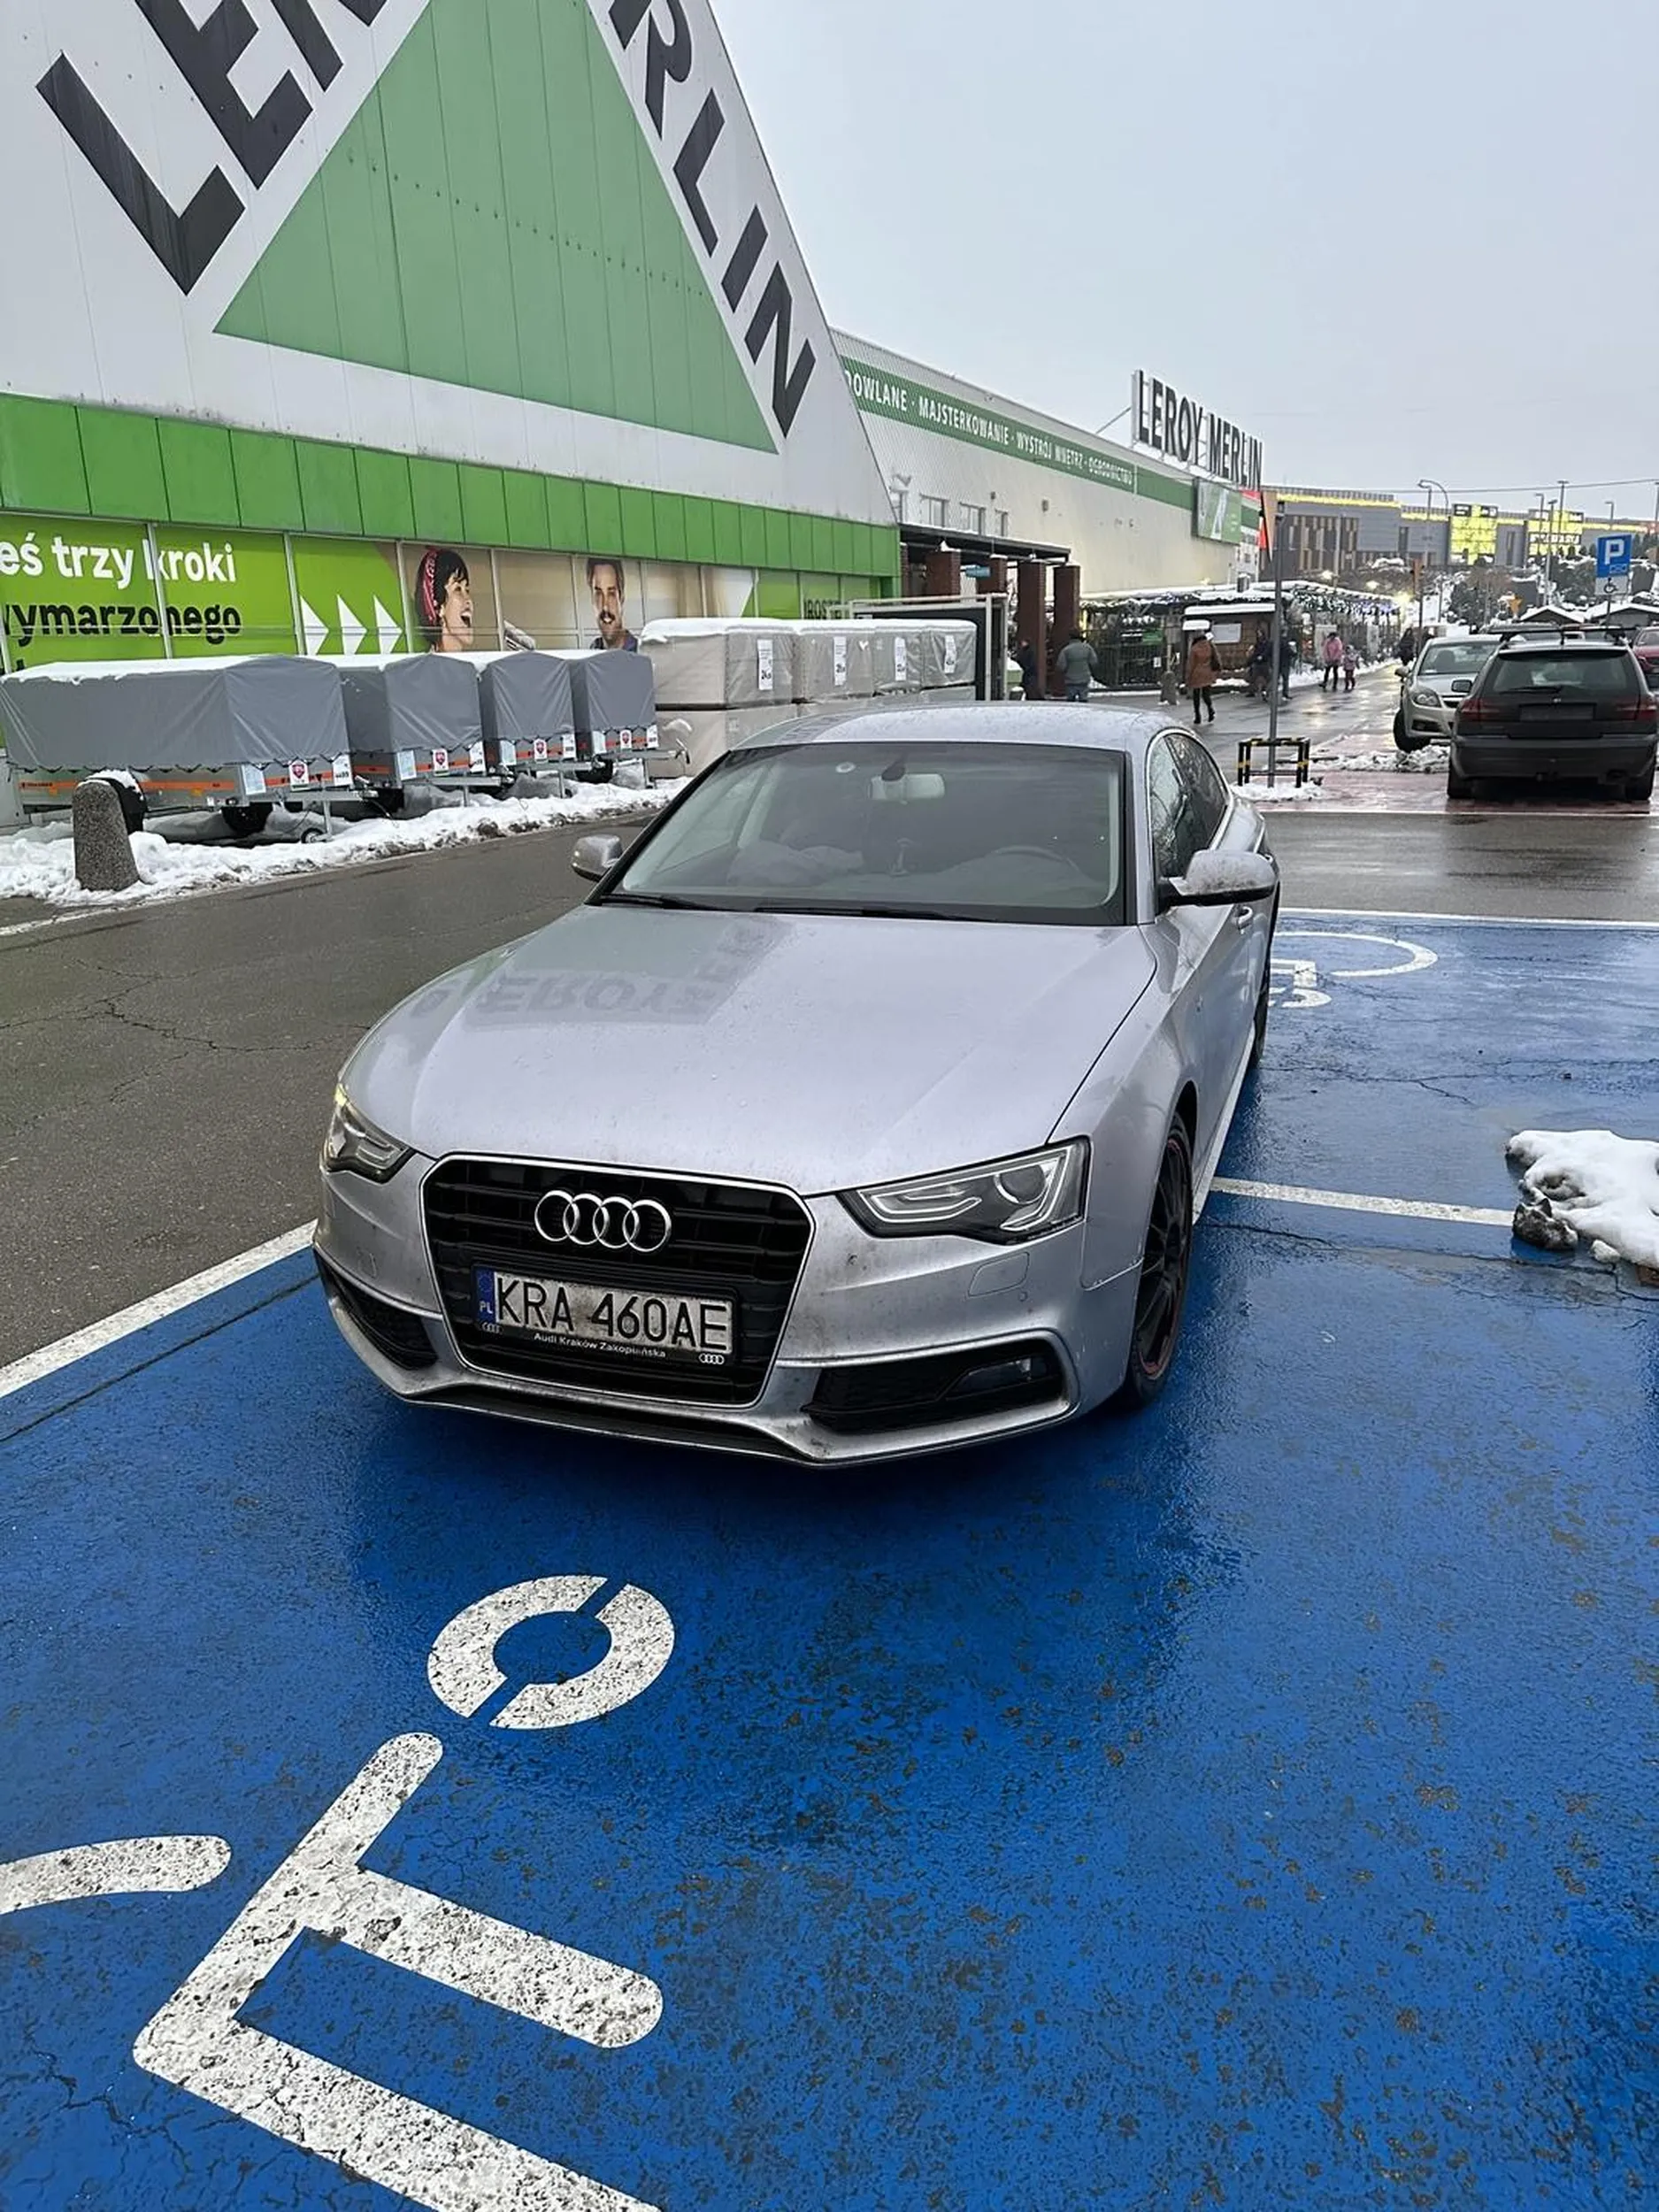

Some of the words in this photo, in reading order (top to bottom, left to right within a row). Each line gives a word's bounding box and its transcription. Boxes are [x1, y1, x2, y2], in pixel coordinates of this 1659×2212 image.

[918, 396, 1010, 446] MAJSTERKOWANIE
[1133, 370, 1203, 466] LEROY
[1207, 412, 1263, 492] MERLIN
[51, 536, 134, 590] trzy
[142, 538, 236, 583] kroki
[1604, 538, 1624, 565] P
[479, 1302, 494, 1315] PL
[497, 1276, 574, 1333] KRA
[590, 1292, 727, 1352] 460AE
[534, 1332, 557, 1344] Audi
[558, 1335, 597, 1350] Kraków
